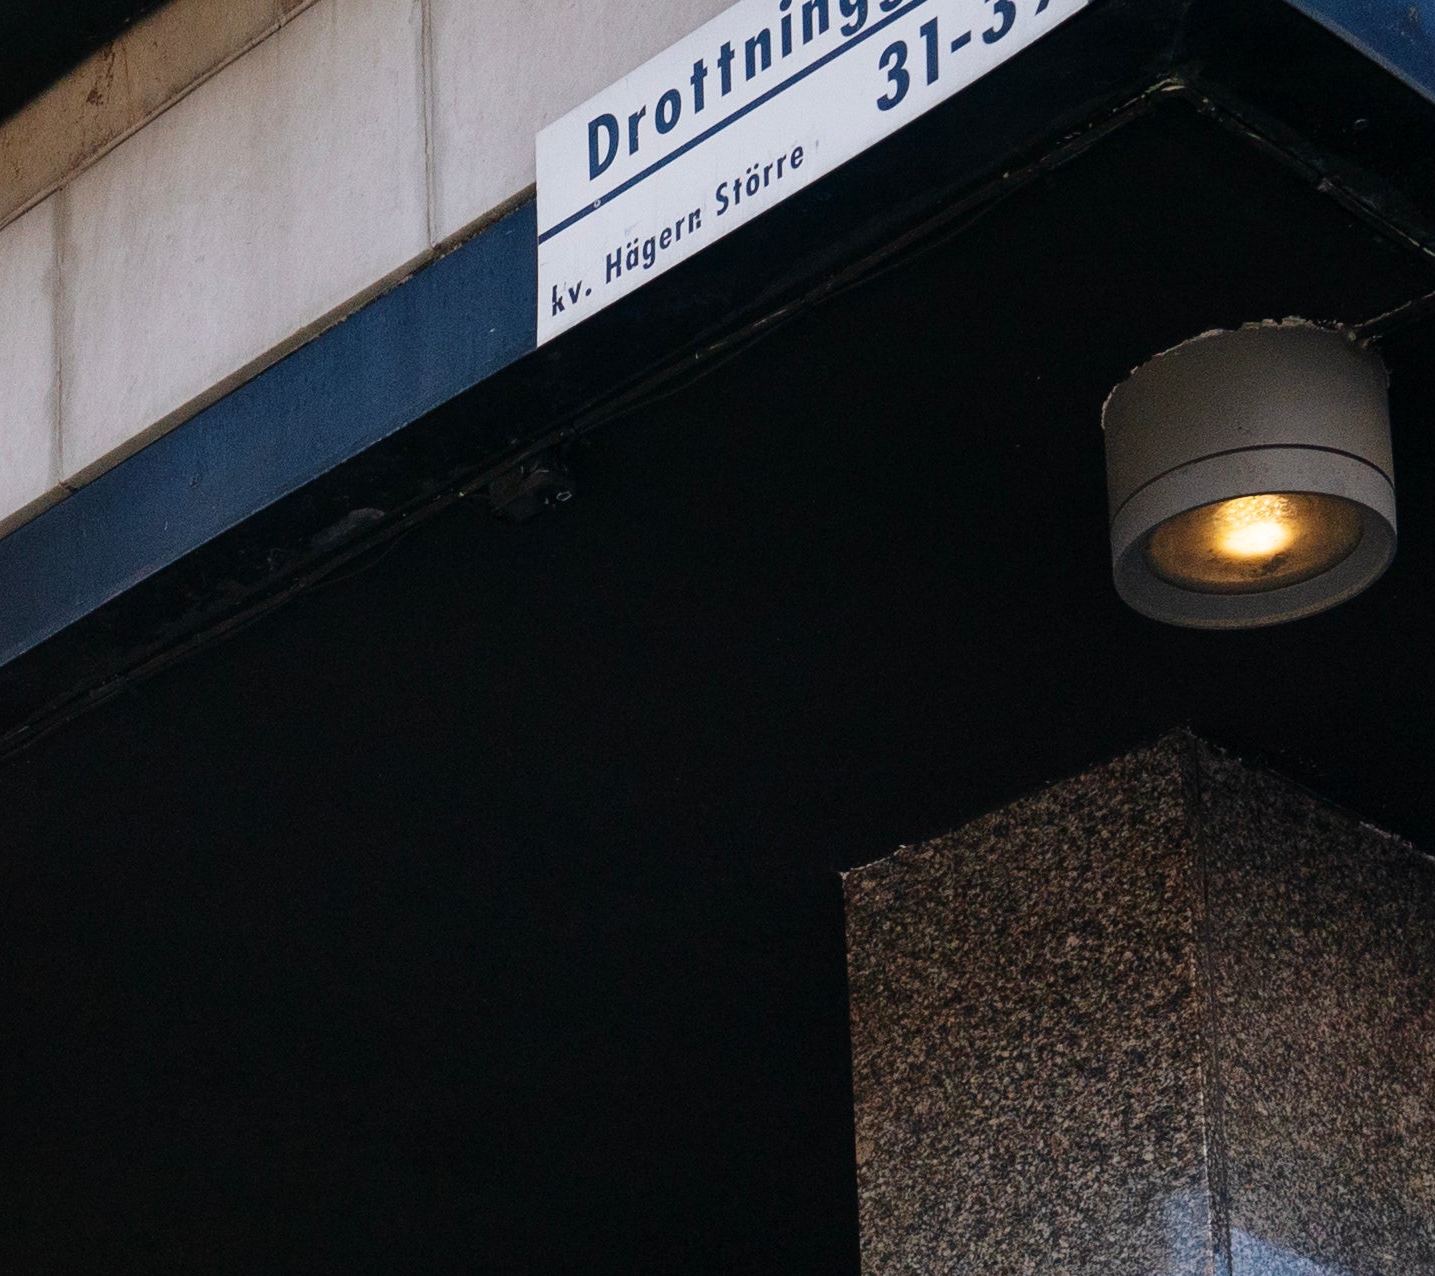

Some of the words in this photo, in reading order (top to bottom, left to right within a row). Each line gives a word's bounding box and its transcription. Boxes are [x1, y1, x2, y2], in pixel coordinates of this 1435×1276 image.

[585, 0, 906, 181] Drottning
[876, 0, 1050, 112] 31-3
[550, 283, 592, 317] kv.
[605, 206, 703, 286] Hägern
[716, 144, 805, 217] Större
